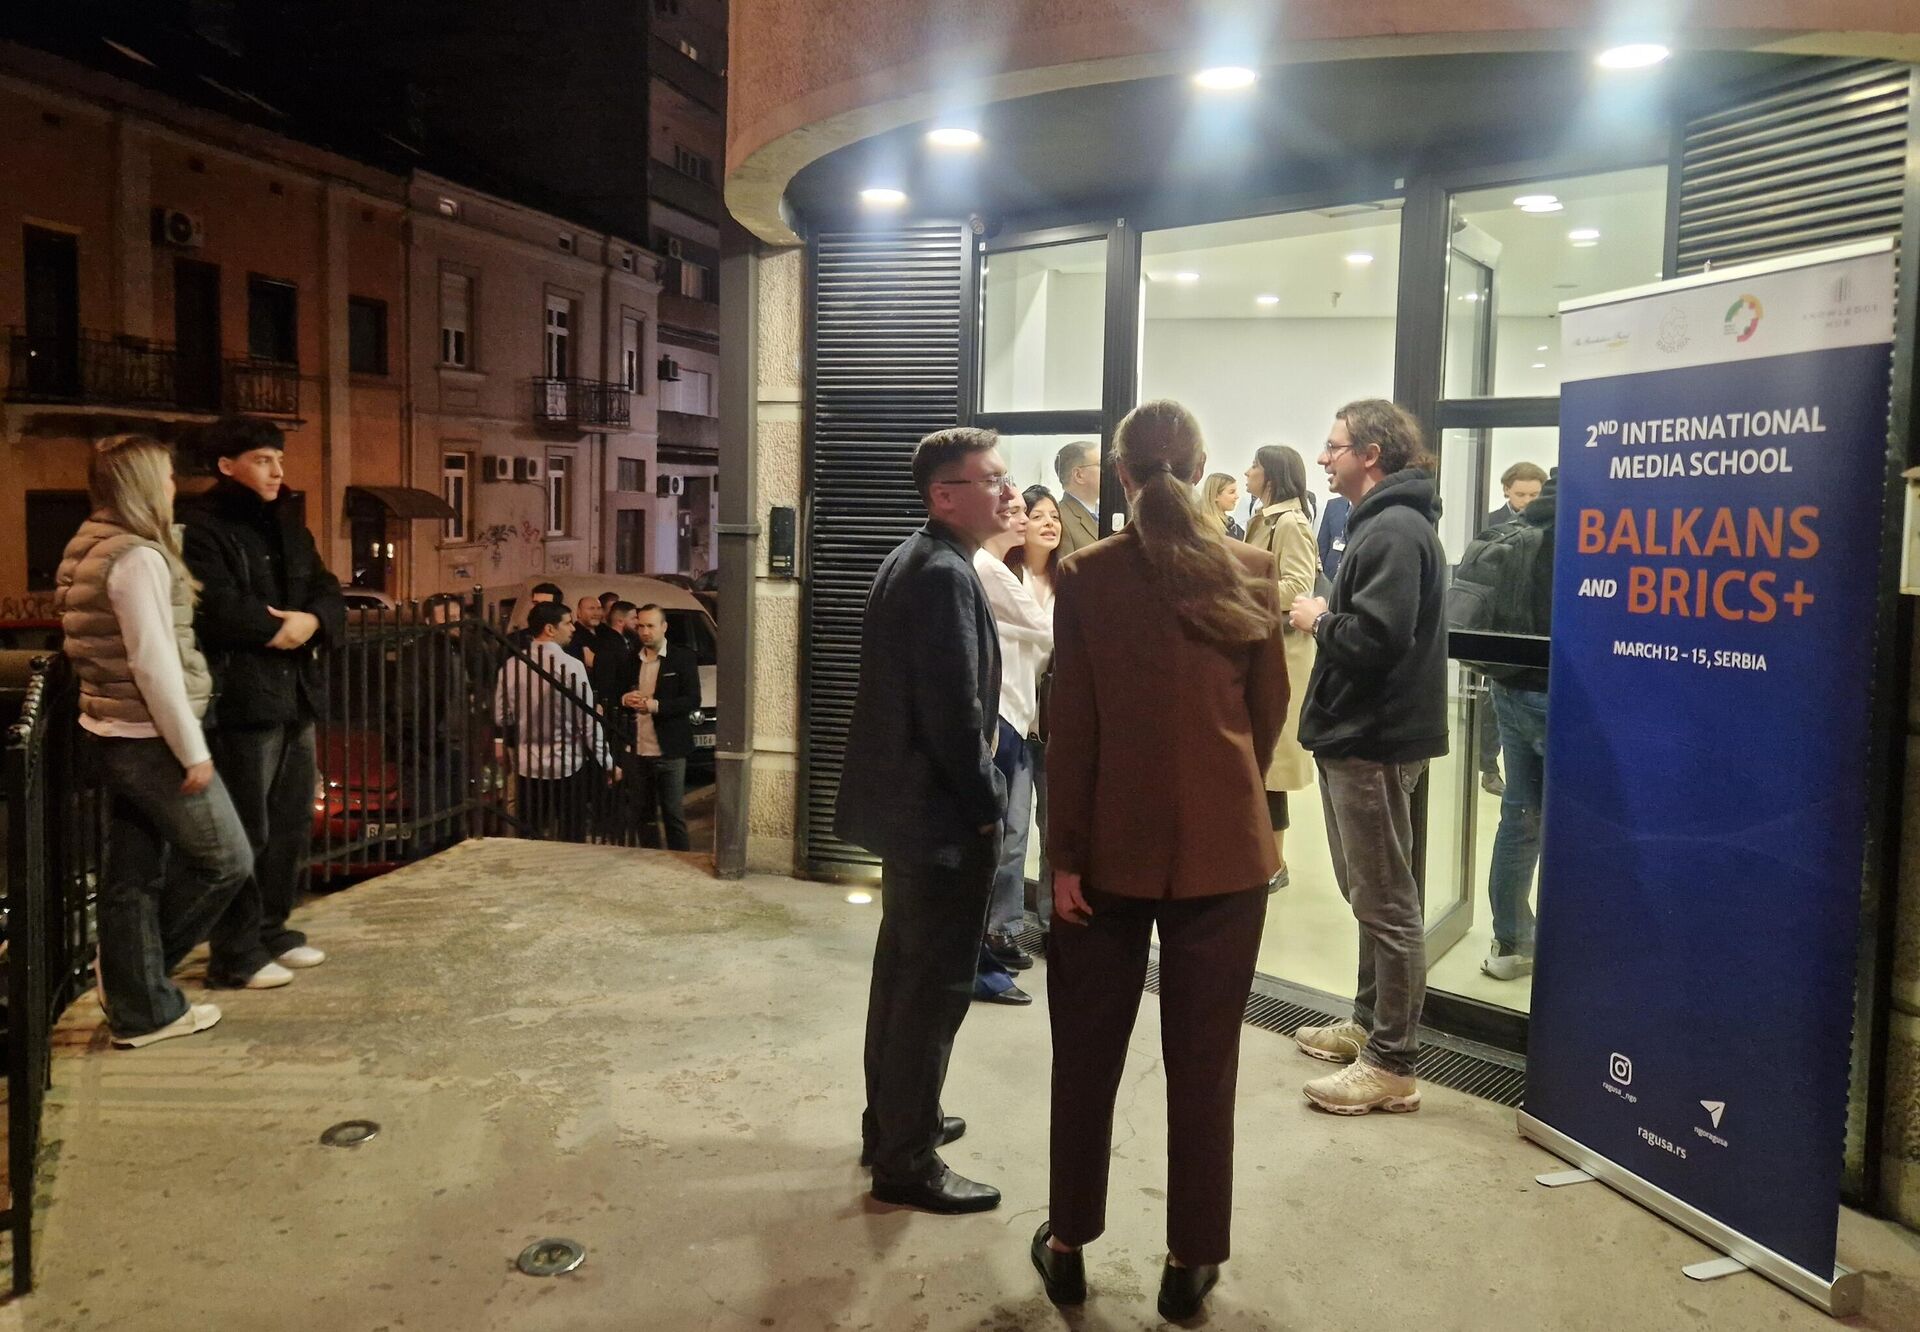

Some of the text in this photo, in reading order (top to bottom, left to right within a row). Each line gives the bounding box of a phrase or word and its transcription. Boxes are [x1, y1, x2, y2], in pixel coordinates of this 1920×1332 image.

[1585, 406, 1827, 448] 2ND INTERNATIONAL
[1609, 447, 1793, 479] MEDIA SCHOOL
[1577, 505, 1821, 559] BALKANS
[1578, 566, 1815, 623] AND BRICS+
[1613, 640, 1662, 660] MARCH
[1664, 646, 1678, 662] 12
[1691, 648, 1711, 669] 15,
[1713, 650, 1767, 671] SERBIA
[1602, 1082, 1637, 1103] ragusa_ngo
[1637, 1126, 1687, 1159] ragusa.rs
